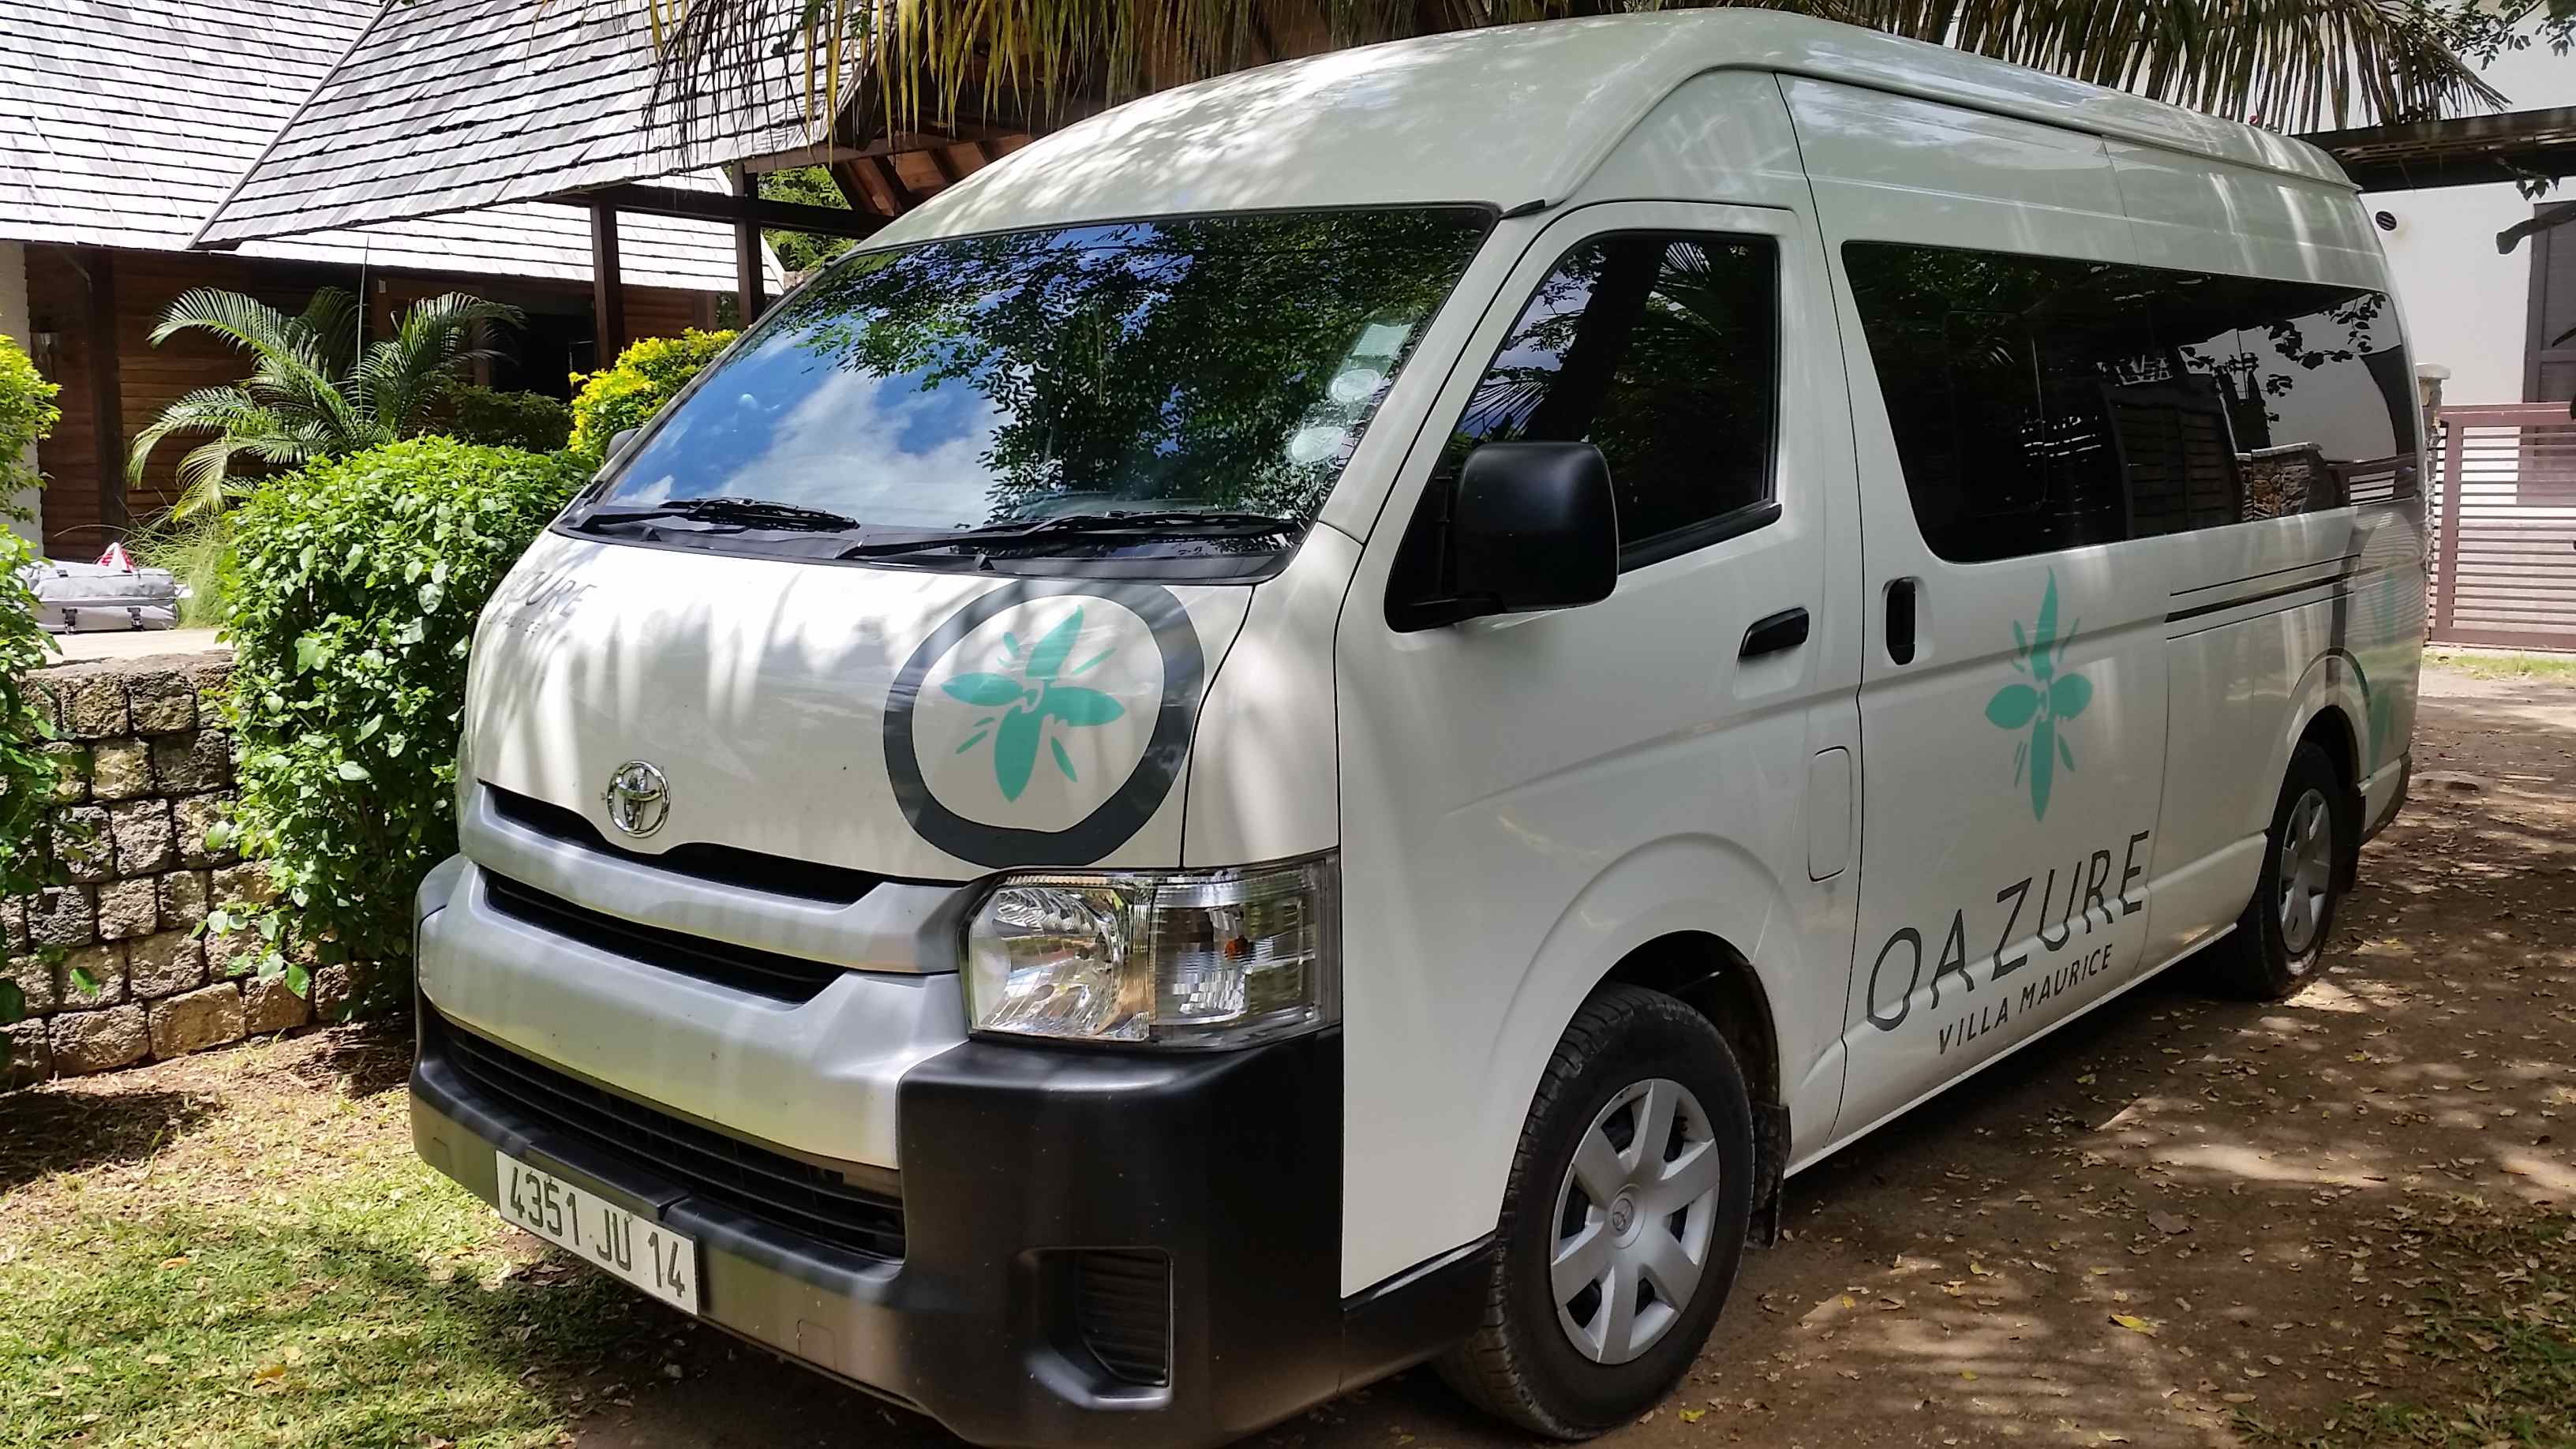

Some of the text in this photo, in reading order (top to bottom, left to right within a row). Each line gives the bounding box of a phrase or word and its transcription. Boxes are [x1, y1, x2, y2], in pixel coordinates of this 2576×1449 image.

[1866, 829, 2150, 1032] OAZURE
[1938, 943, 2113, 1055] VILLA MAURICE
[510, 1166, 686, 1298] 4351 JU 14
